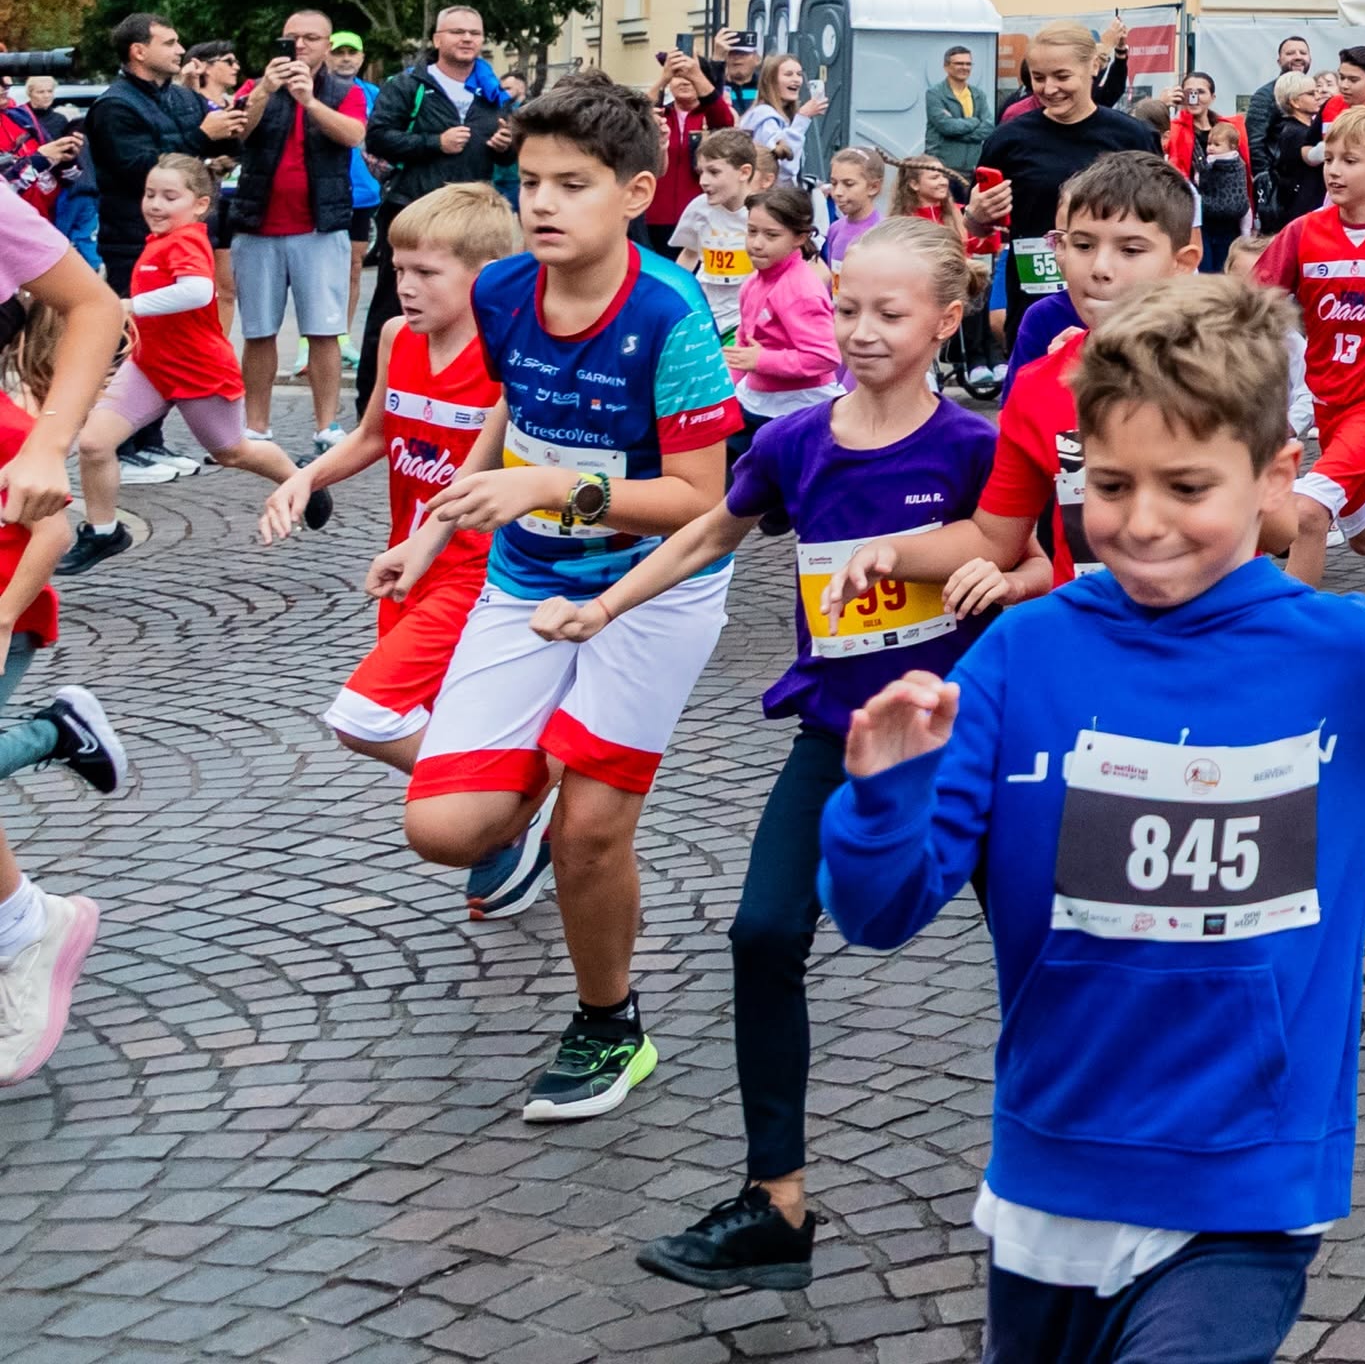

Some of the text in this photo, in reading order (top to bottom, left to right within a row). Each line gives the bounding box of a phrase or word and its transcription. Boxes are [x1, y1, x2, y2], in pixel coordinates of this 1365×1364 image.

[709, 250, 735, 269] 792
[1033, 253, 1061, 276] 55
[1332, 333, 1361, 364] 13
[576, 369, 627, 387] GARMIN
[525, 420, 615, 447] FrescoVerde
[390, 436, 457, 486] Orade
[905, 492, 944, 505] IULIA R.
[839, 578, 907, 618] 99
[1126, 814, 1261, 892] 845
